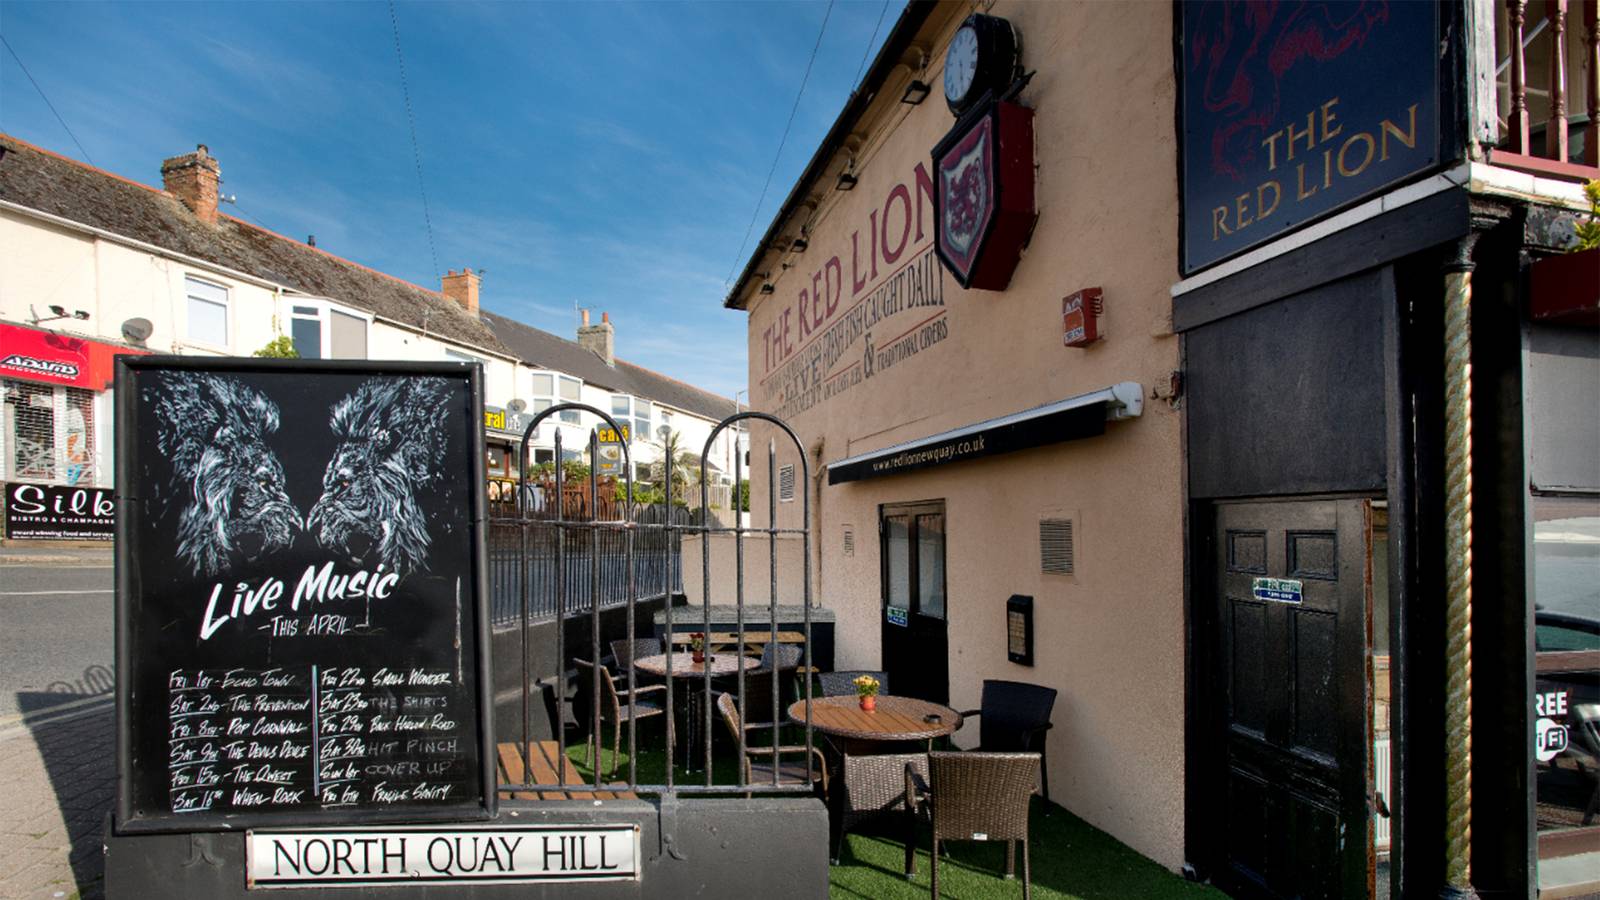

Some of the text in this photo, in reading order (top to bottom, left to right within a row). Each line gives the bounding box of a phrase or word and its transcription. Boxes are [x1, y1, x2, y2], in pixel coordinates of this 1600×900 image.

[1262, 97, 1344, 171] THE
[1212, 104, 1418, 241] RED LION
[864, 268, 906, 330] CAUGHT
[907, 248, 945, 309] DAILY
[763, 307, 793, 374] THE
[799, 255, 842, 343] RED
[863, 332, 875, 379] &
[919, 316, 949, 351] CIDERS
[784, 353, 822, 403] LIVE
[872, 435, 985, 471] www.redlionnewquay.co.uk
[11, 485, 115, 516] Silk
[200, 561, 399, 640] Live Music
[221, 667, 258, 690] ECHO
[261, 667, 296, 688] TOWN
[408, 667, 452, 686] WONDER
[230, 693, 252, 713] THE
[253, 693, 311, 713] PREVENTION
[369, 697, 398, 709] THE
[403, 696, 448, 708] SHIRTS
[1536, 691, 1568, 717] REE
[226, 717, 251, 737] POP
[252, 716, 308, 737] CORNWALL
[430, 712, 456, 731] ROAD
[367, 740, 400, 756] HIT
[406, 739, 457, 754] PINCH
[365, 761, 420, 775] COVER
[426, 761, 452, 776] UP
[271, 787, 305, 803] ROCK
[273, 835, 619, 877] NORTH QUAY HILL
